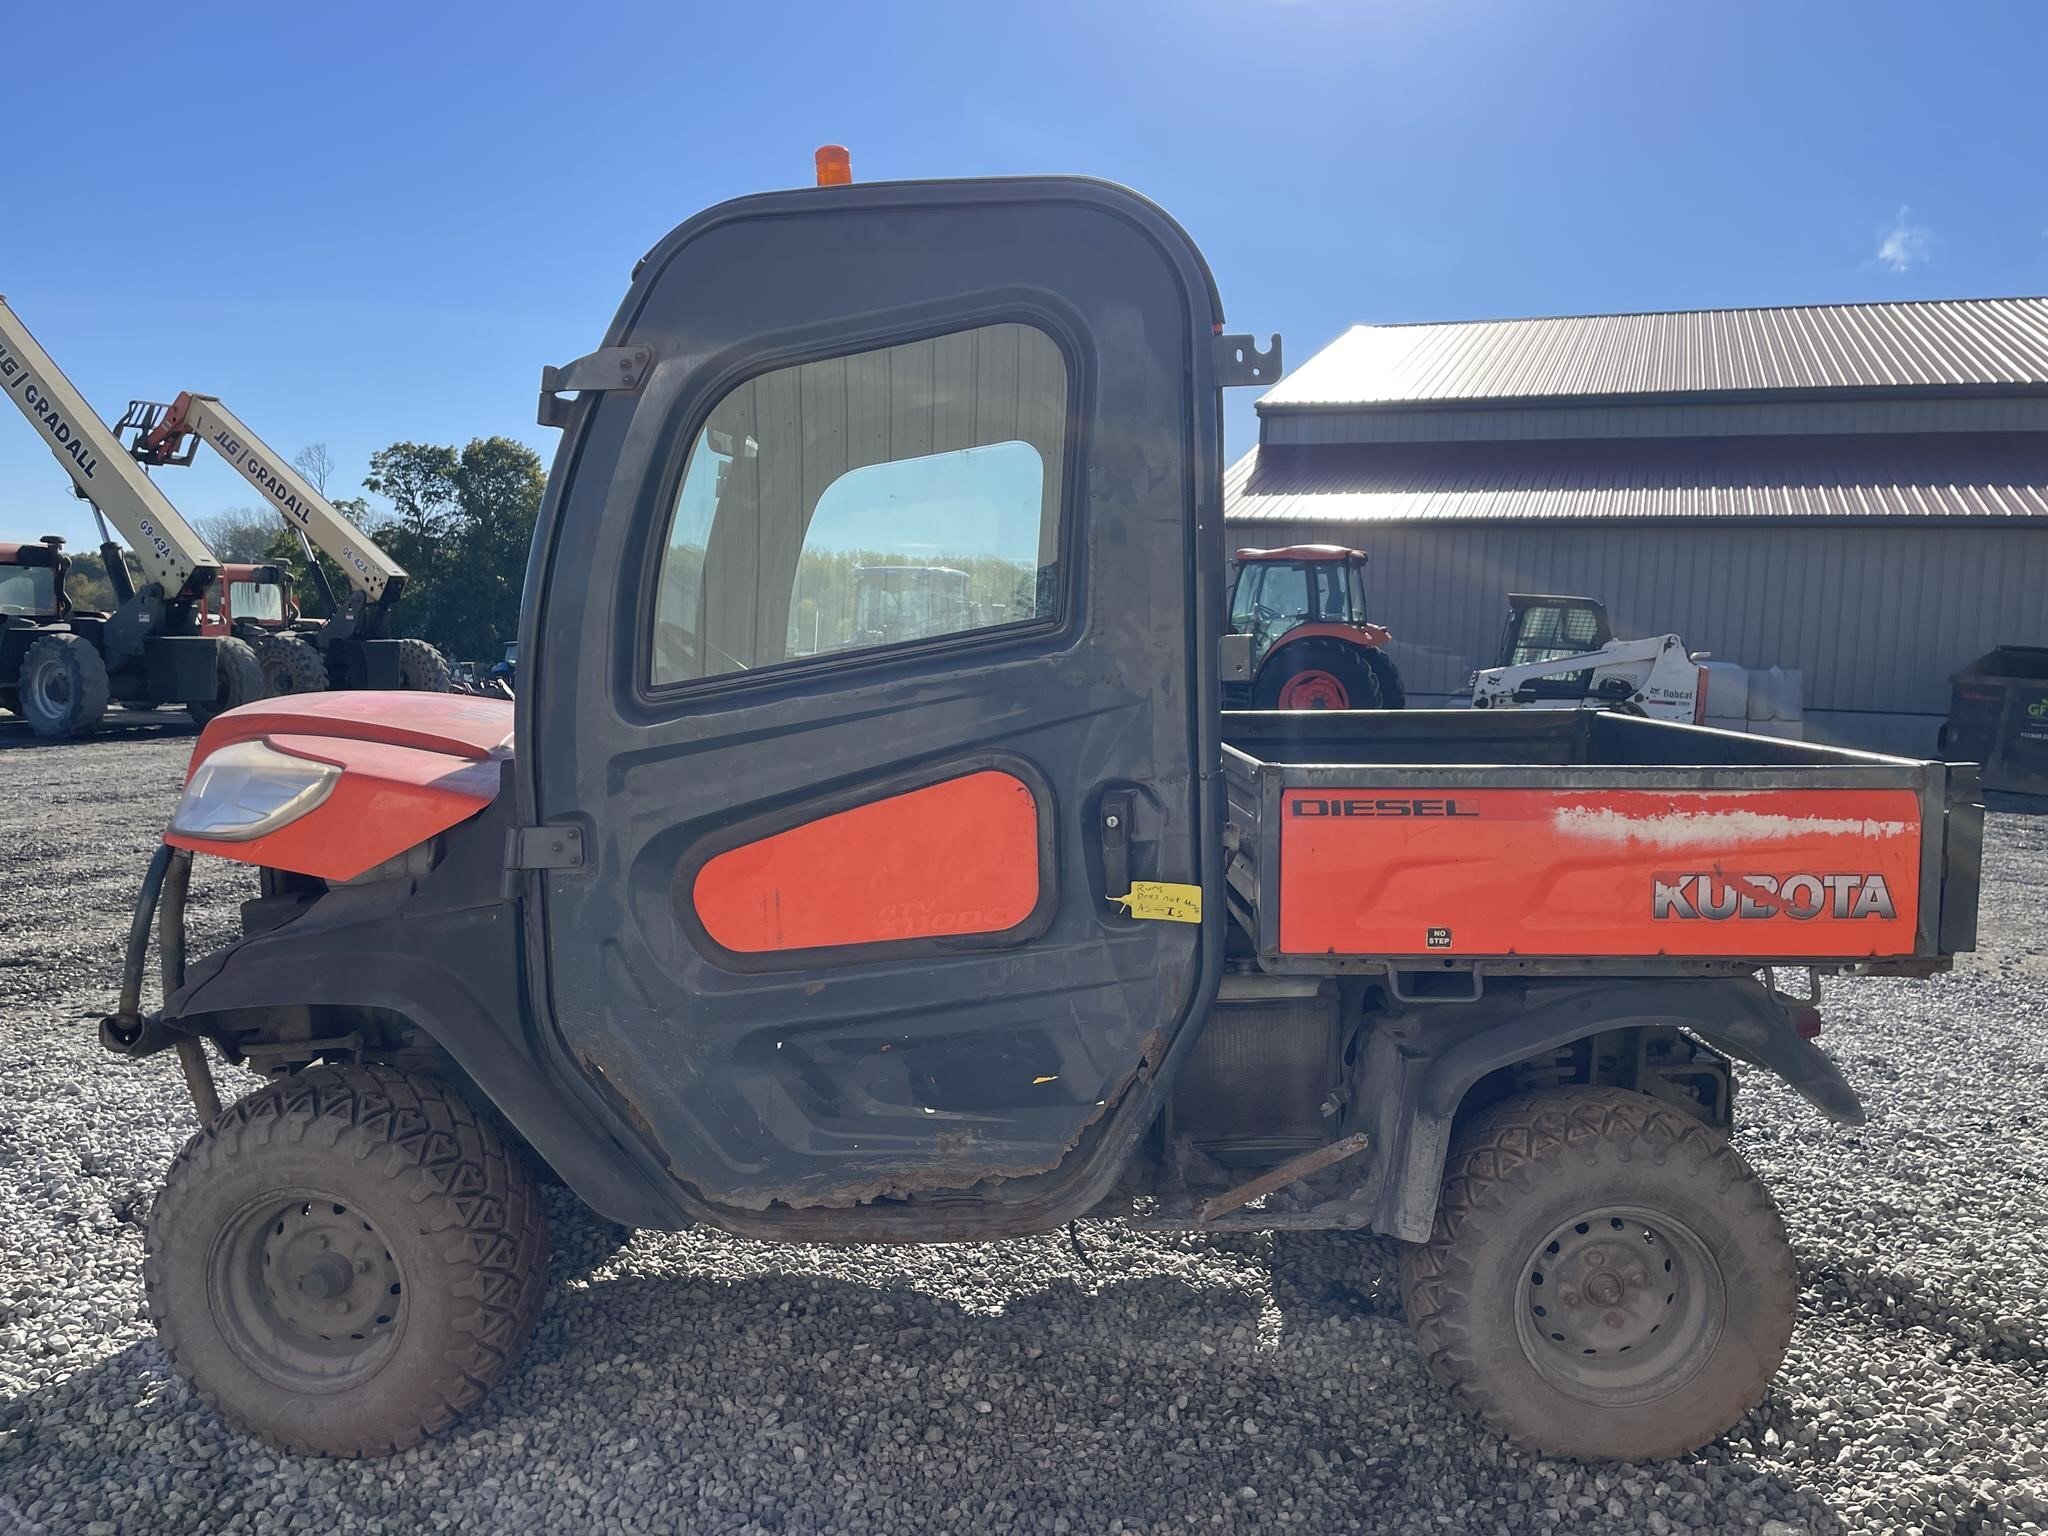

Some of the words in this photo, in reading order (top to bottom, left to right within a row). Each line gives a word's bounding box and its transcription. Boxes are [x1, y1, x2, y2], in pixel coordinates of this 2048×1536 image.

[25, 384, 97, 479] GRADALL
[213, 431, 241, 456] JLG
[247, 458, 310, 525] GRADALL
[1664, 689, 1692, 700] Bobcat
[1292, 799, 1478, 816] DIESEL
[1653, 873, 1898, 920] KUBOTA
[1428, 937, 1450, 945] STEP
